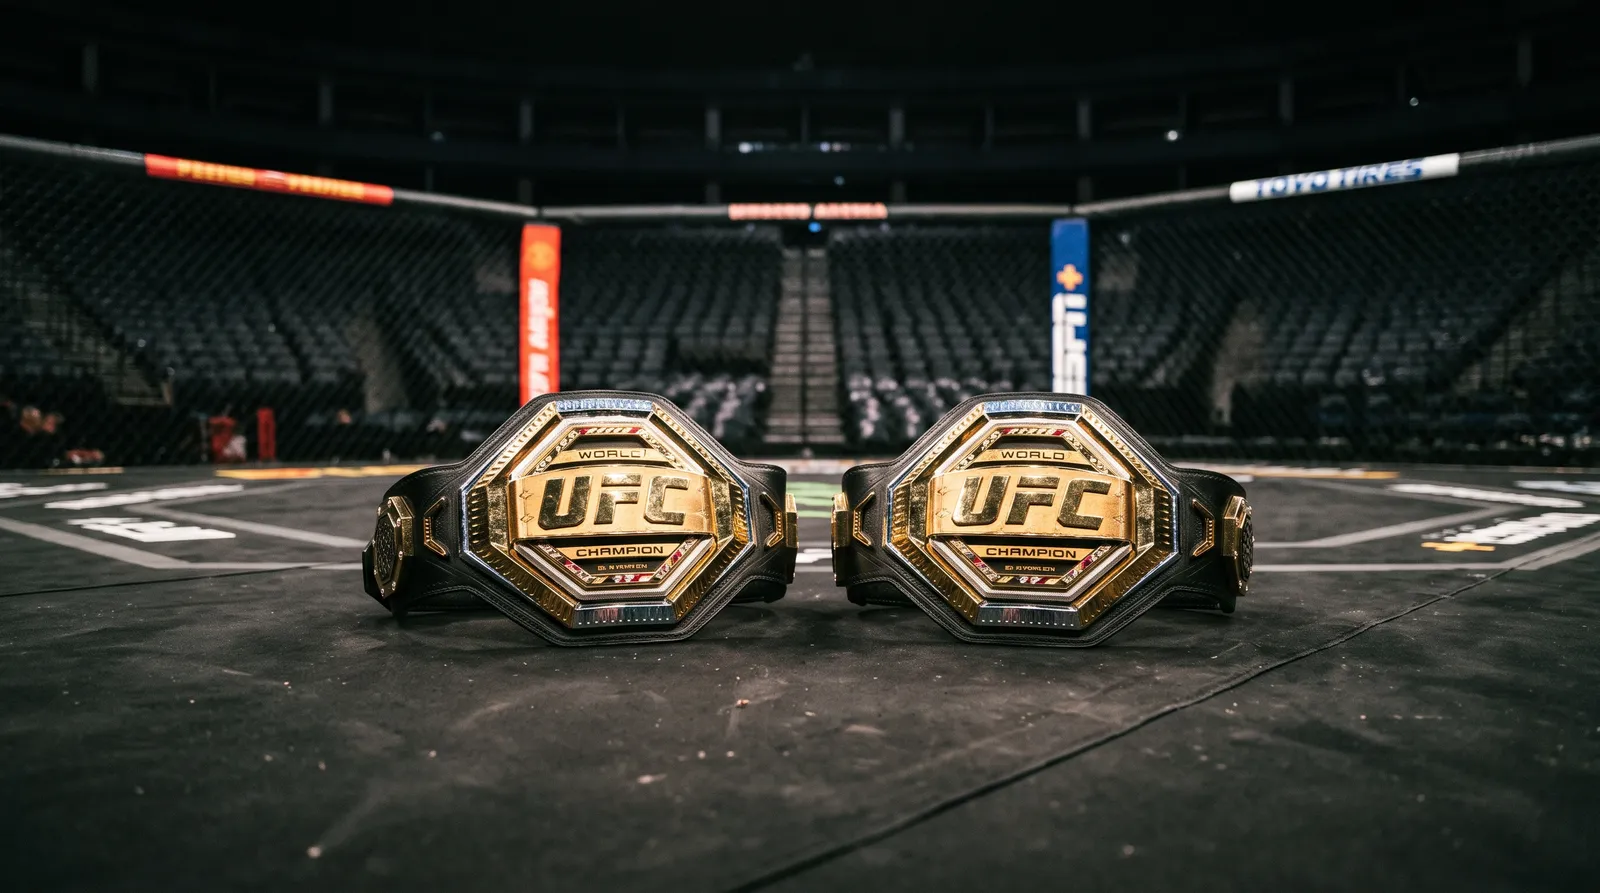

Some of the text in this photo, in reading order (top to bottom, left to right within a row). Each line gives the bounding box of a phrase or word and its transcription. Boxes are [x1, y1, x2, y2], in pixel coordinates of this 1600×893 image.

[1001, 450, 1064, 460] WORLD
[538, 473, 690, 530] UFC
[951, 475, 1112, 531] UFC
[576, 546, 664, 557] CHAMPION
[986, 548, 1077, 559] CHAMPION
